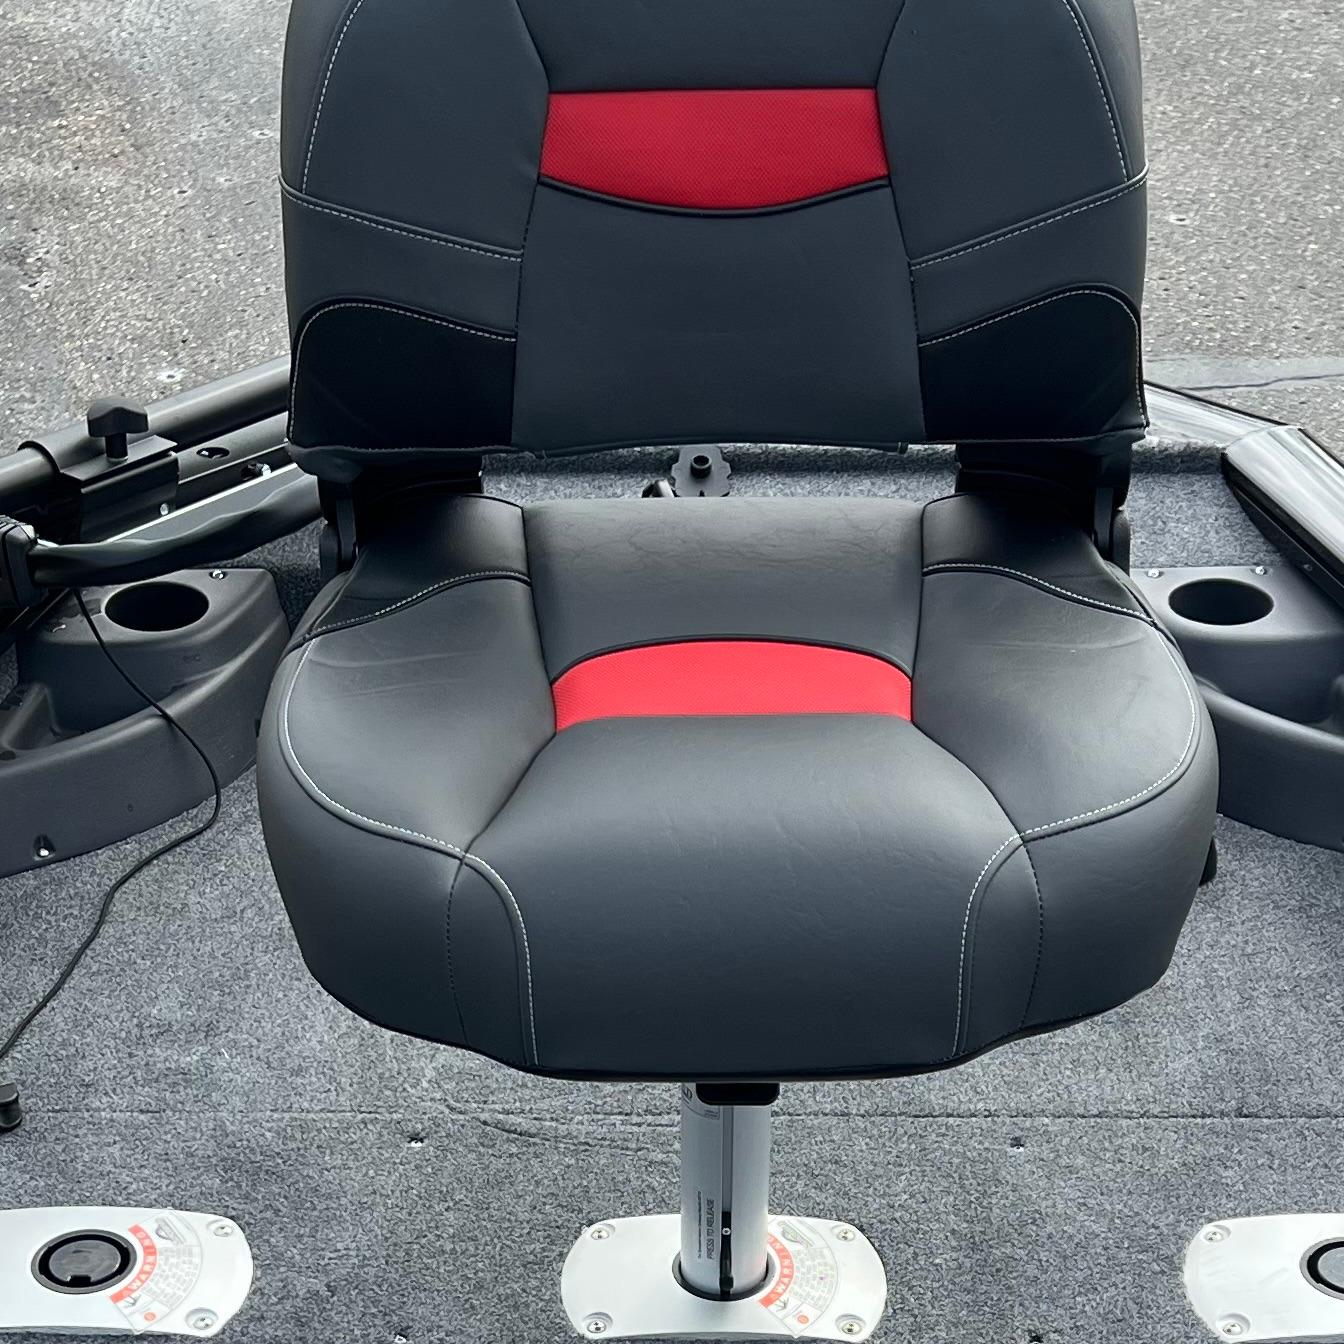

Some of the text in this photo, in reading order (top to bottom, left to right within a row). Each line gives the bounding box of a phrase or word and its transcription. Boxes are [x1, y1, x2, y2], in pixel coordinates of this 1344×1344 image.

[706, 1198, 715, 1228] RELEASE
[128, 1231, 156, 1289] WARNING
[706, 1238, 715, 1259] PRESS
